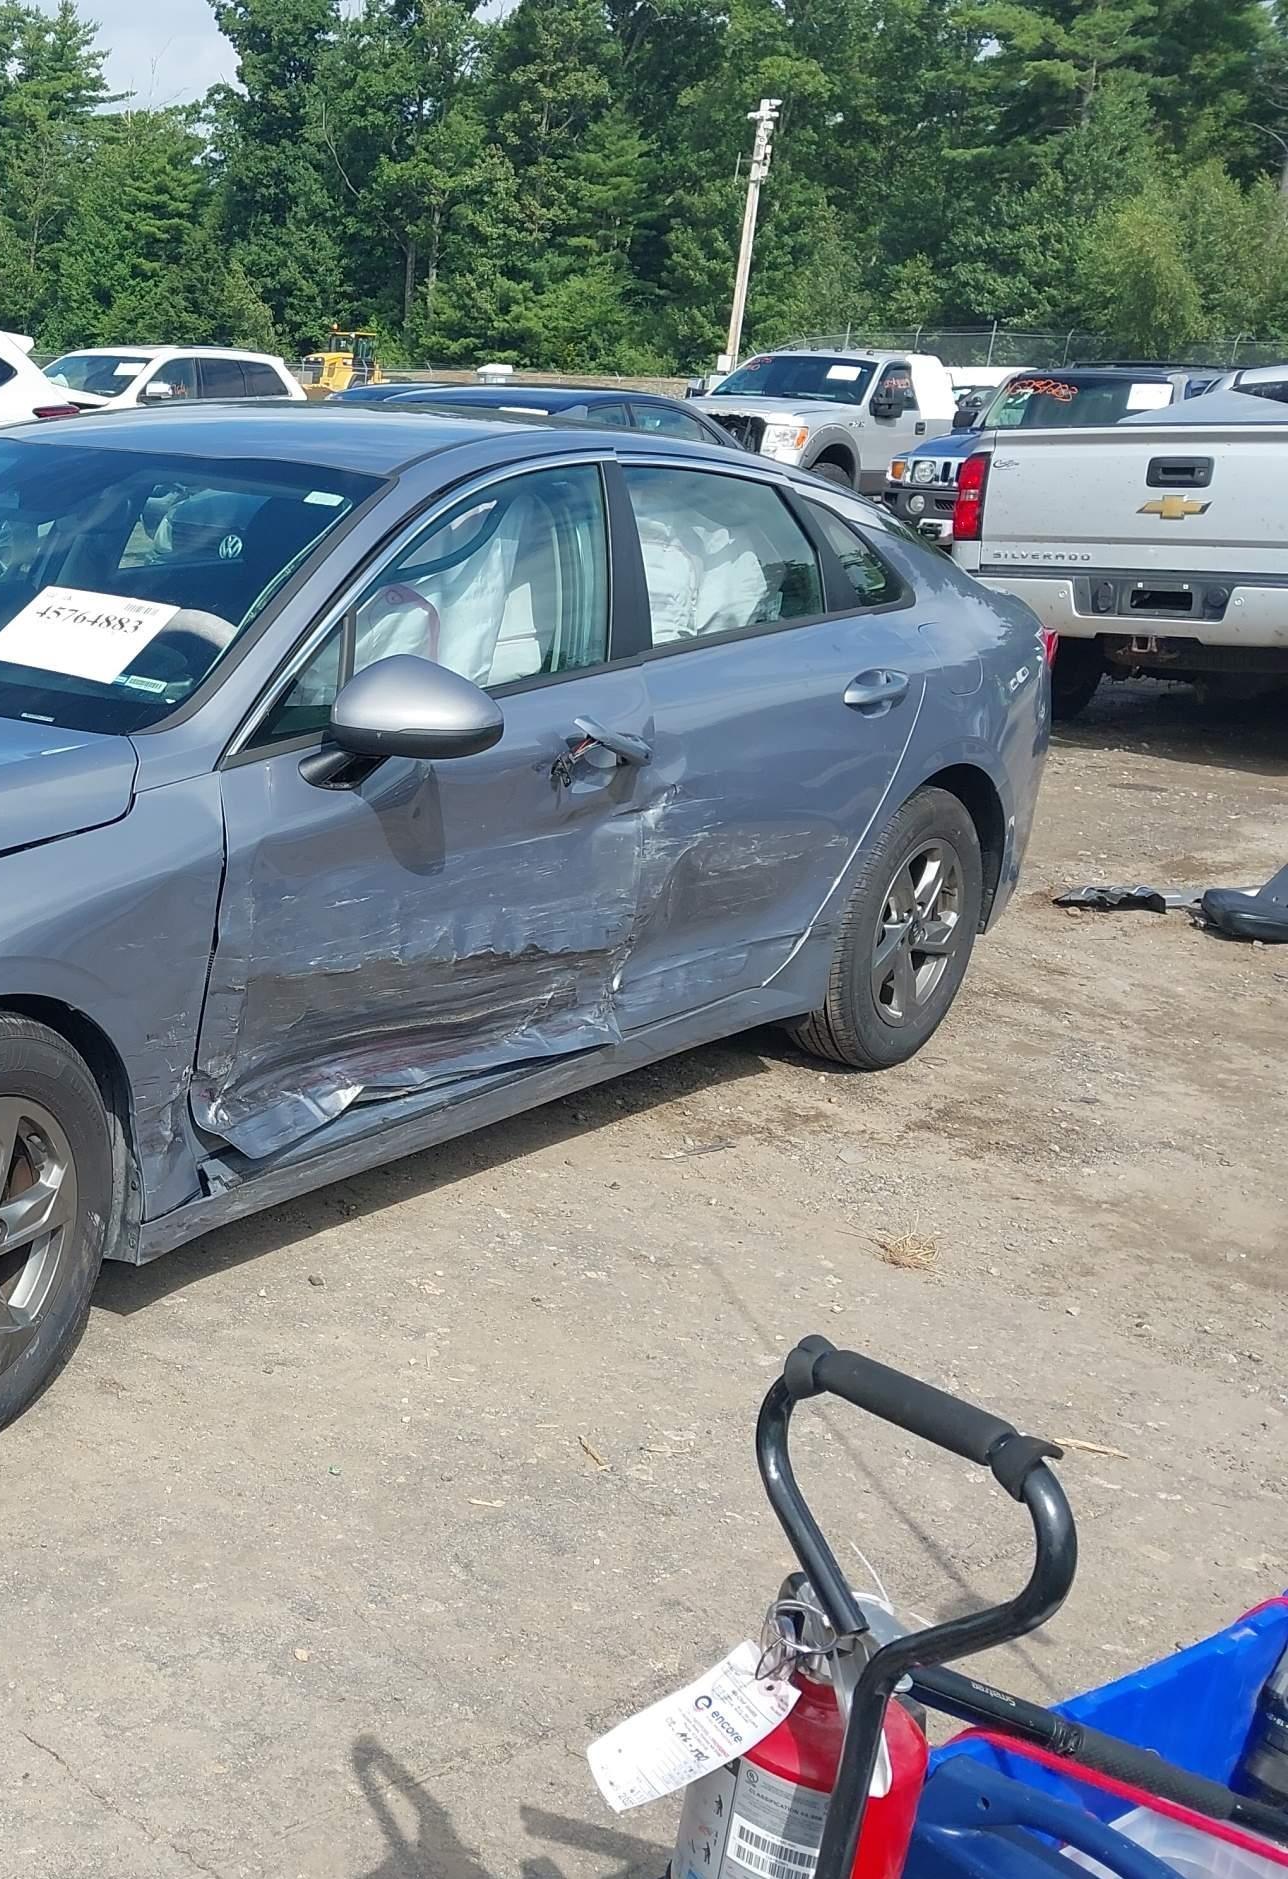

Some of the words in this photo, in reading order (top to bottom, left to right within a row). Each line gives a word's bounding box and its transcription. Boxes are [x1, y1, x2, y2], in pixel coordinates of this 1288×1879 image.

[992, 552, 1091, 561] SILVERADO
[35, 604, 144, 634] 45764883
[712, 1709, 743, 1744] encore
